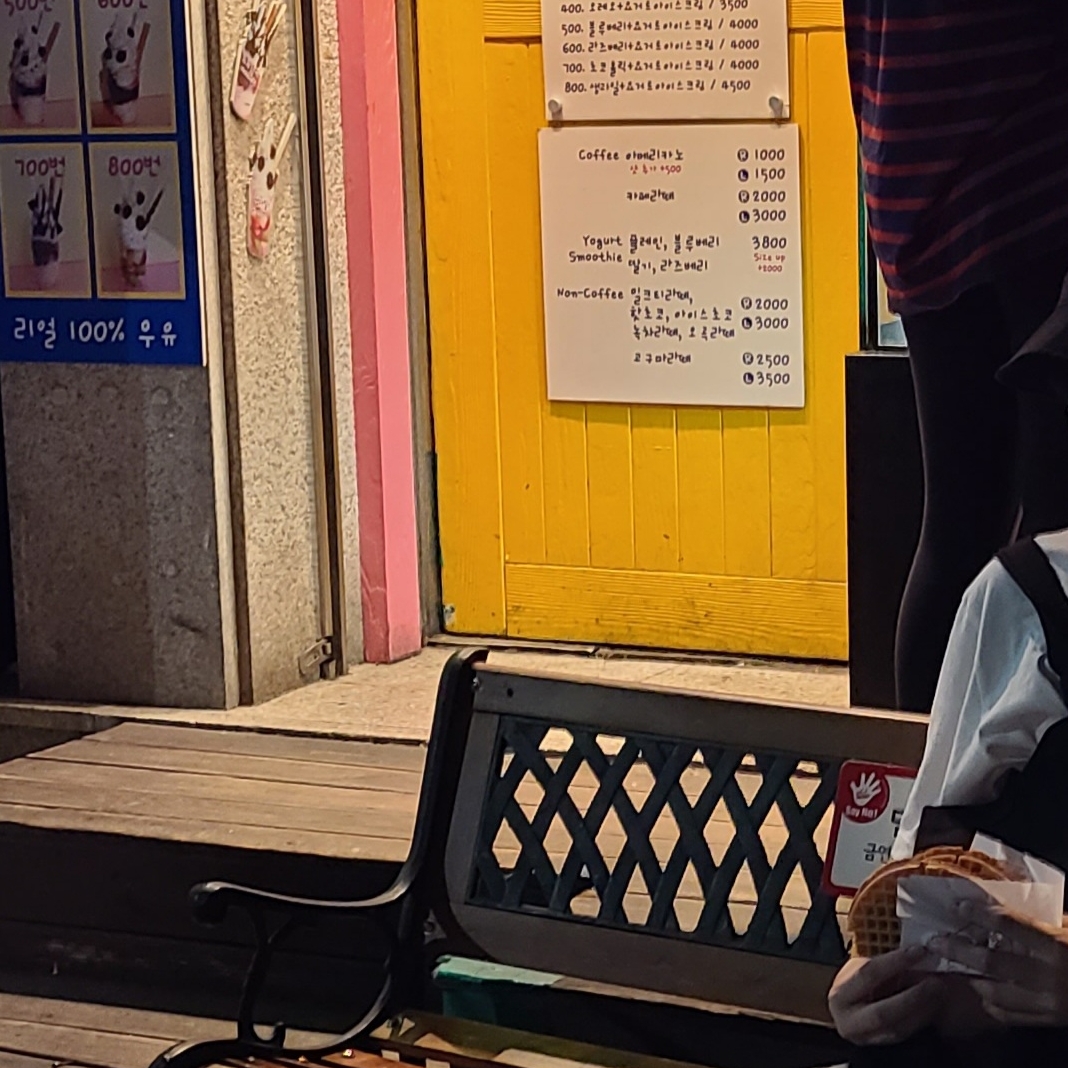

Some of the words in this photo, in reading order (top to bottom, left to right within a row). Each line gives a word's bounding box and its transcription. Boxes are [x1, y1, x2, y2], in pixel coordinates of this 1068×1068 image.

[561, 23, 584, 37] 500.
[729, 18, 759, 30] 4000
[562, 42, 586, 54] 600.
[730, 39, 760, 50] 4000
[562, 62, 586, 74] 700.
[729, 59, 760, 71] 4000
[564, 81, 588, 94] 800.
[721, 79, 751, 93] 4500
[578, 148, 620, 161] Coffee
[625, 148, 684, 162] 아메리카노
[754, 148, 785, 162] 1000
[107, 155, 162, 178] 800번
[755, 167, 786, 184] 1500
[752, 190, 786, 203] 2000
[752, 208, 787, 224] 3000
[582, 234, 623, 251] Yogurt
[751, 235, 787, 251] 3800
[568, 250, 623, 263] Smoothie
[556, 287, 624, 300] Non-Coffee
[755, 297, 789, 311] 2000
[754, 315, 789, 331] 3000
[69, 318, 125, 344] 100%
[138, 318, 178, 349] 우유
[756, 353, 790, 369] 2500
[756, 370, 791, 388] 3500
